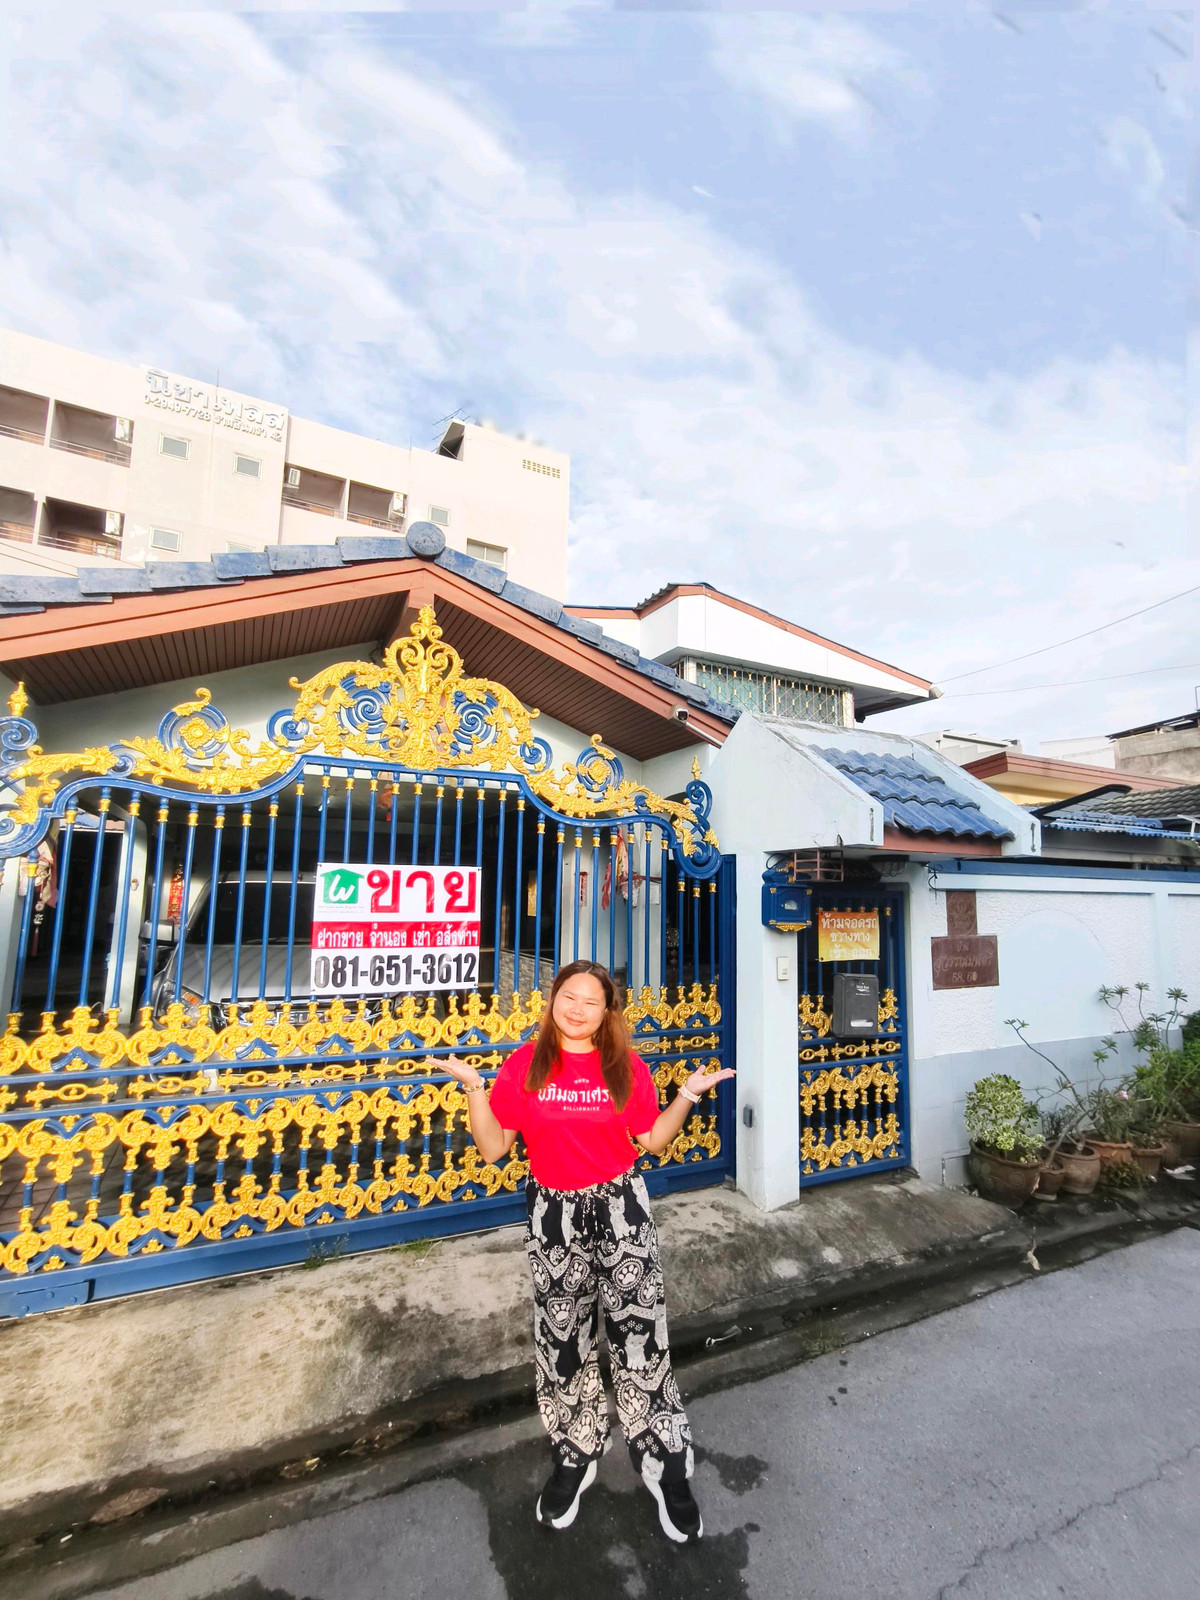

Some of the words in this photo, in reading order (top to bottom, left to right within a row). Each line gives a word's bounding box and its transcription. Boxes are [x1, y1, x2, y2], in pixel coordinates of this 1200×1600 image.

[366, 869, 477, 914] ขาย
[821, 912, 878, 929] ห้ามจอดรถ
[317, 928, 364, 948] ฝากขาย
[370, 923, 408, 947] จำนอง
[413, 923, 431, 947] เช่า
[436, 924, 478, 946] อสังหาฯ
[830, 932, 870, 943] ขวางทาง
[314, 952, 477, 989] 081-651-3612
